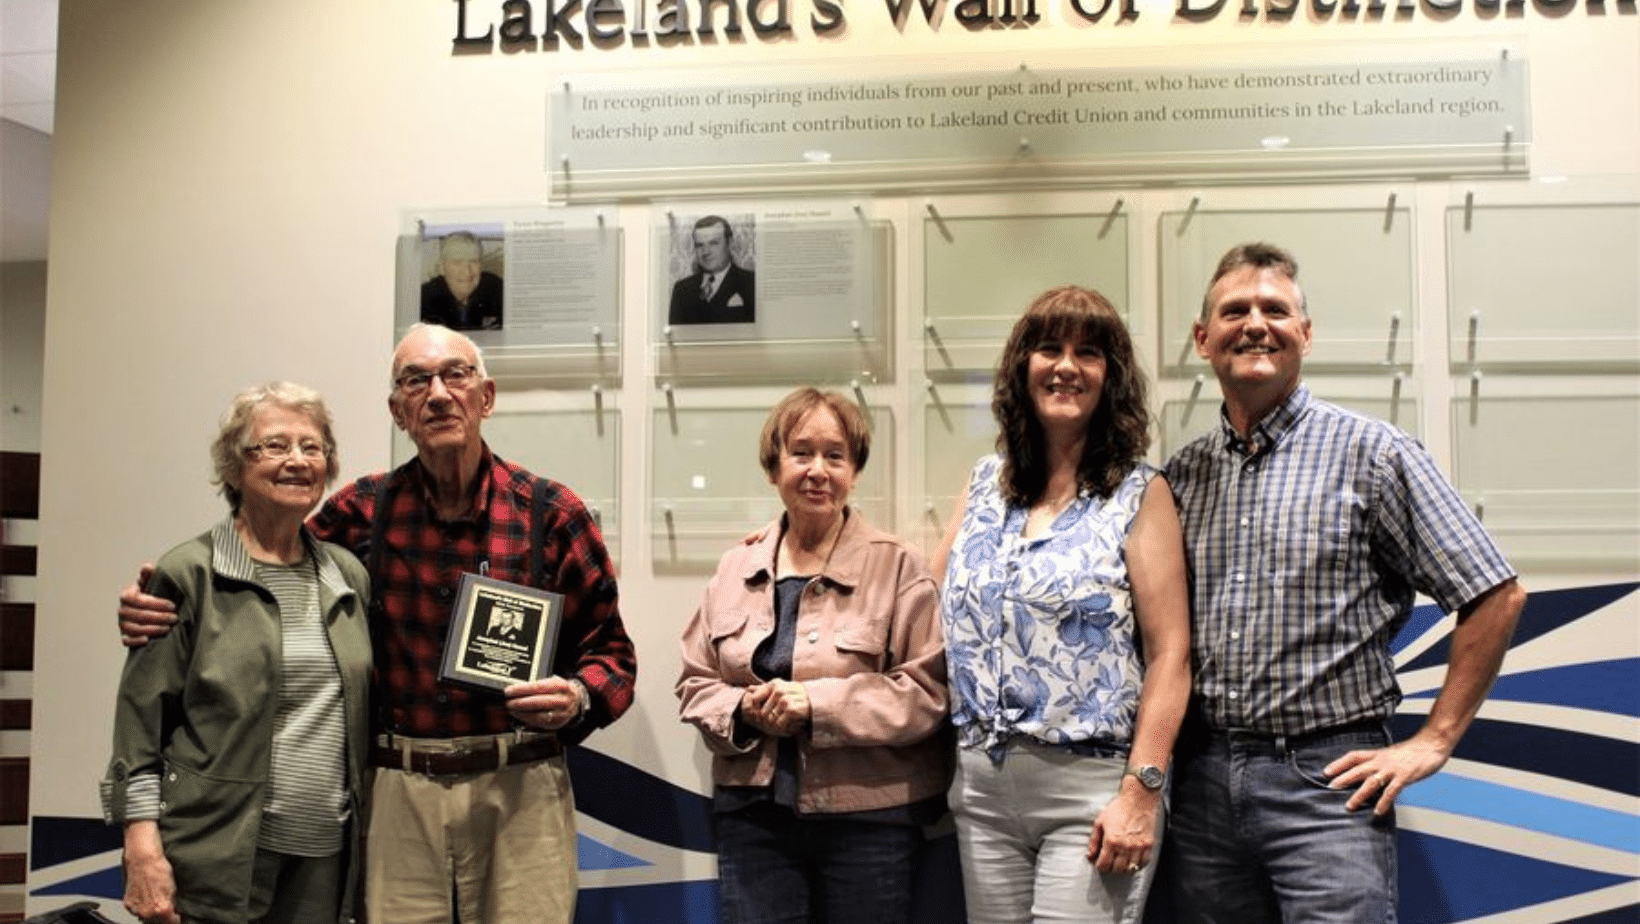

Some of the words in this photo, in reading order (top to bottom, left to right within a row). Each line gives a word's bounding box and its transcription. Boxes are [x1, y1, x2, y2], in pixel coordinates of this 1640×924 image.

[451, 0, 846, 50] Lakelands
[582, 95, 599, 111] In
[603, 91, 700, 112] recognition
[704, 89, 723, 106] of
[727, 88, 803, 108] inspiring
[806, 83, 900, 102] individuals
[904, 82, 947, 99] from
[951, 84, 983, 98] our
[986, 80, 1024, 101] past
[1028, 78, 1062, 95] and
[1067, 78, 1140, 98] present,
[1145, 75, 1183, 91] who
[1187, 74, 1230, 90] have
[1234, 69, 1361, 89] demonstrated
[1366, 66, 1493, 87] extraordinary
[571, 122, 659, 141] leadership
[662, 120, 694, 137] and
[699, 117, 787, 139] significant
[792, 113, 902, 132] contribution
[906, 115, 925, 129] to
[930, 110, 1009, 128] Lakeland
[1013, 107, 1070, 126] Credit
[1074, 105, 1129, 124] Union
[1133, 105, 1167, 122] and
[1171, 101, 1290, 121] communities
[1295, 101, 1312, 118] in
[1316, 99, 1349, 117] the
[1352, 97, 1435, 116] Lakeland
[1440, 97, 1505, 118] region.
